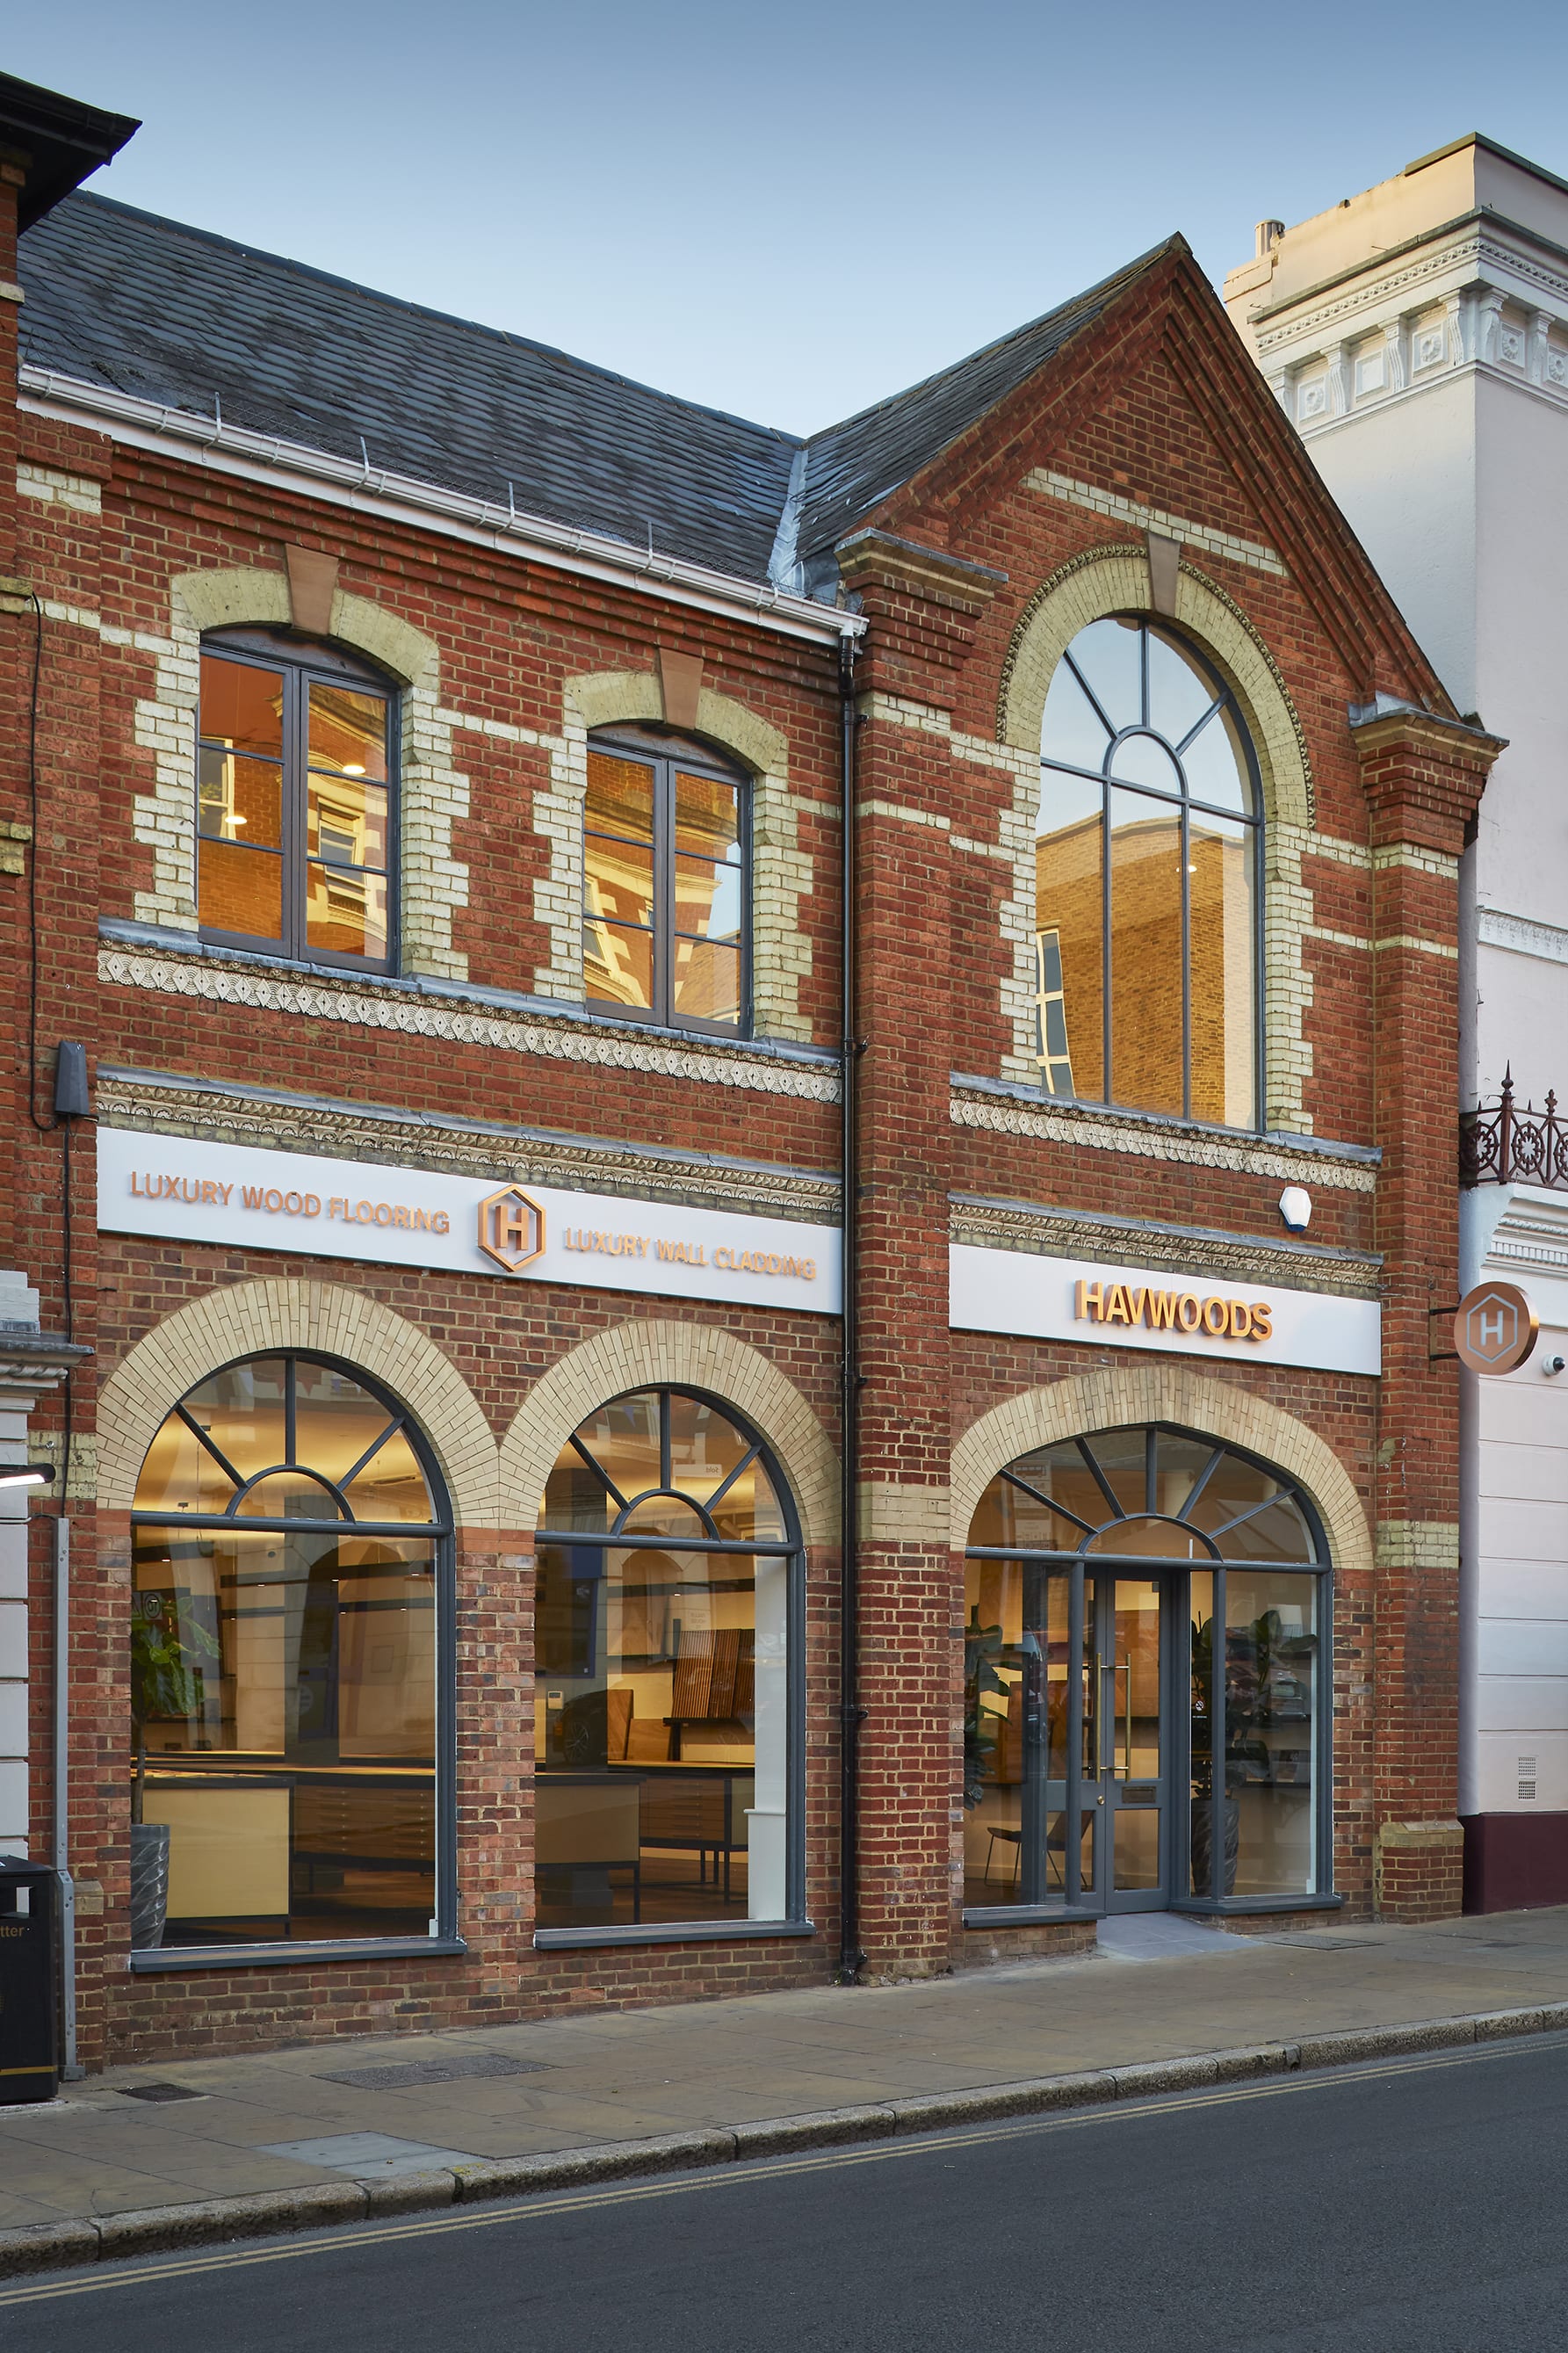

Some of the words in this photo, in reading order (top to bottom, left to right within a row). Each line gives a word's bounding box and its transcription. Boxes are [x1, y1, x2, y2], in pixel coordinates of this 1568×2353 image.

[131, 1170, 234, 1207] LUXURY
[242, 1184, 322, 1217] WOOD
[329, 1197, 450, 1234] FLOORING
[495, 1205, 529, 1251] H
[566, 1227, 651, 1258] LUXURY
[656, 1239, 709, 1266] WALL
[715, 1246, 818, 1280] CLADDING
[1074, 1279, 1274, 1342] HAVWOODS
[1480, 1310, 1504, 1346] H
